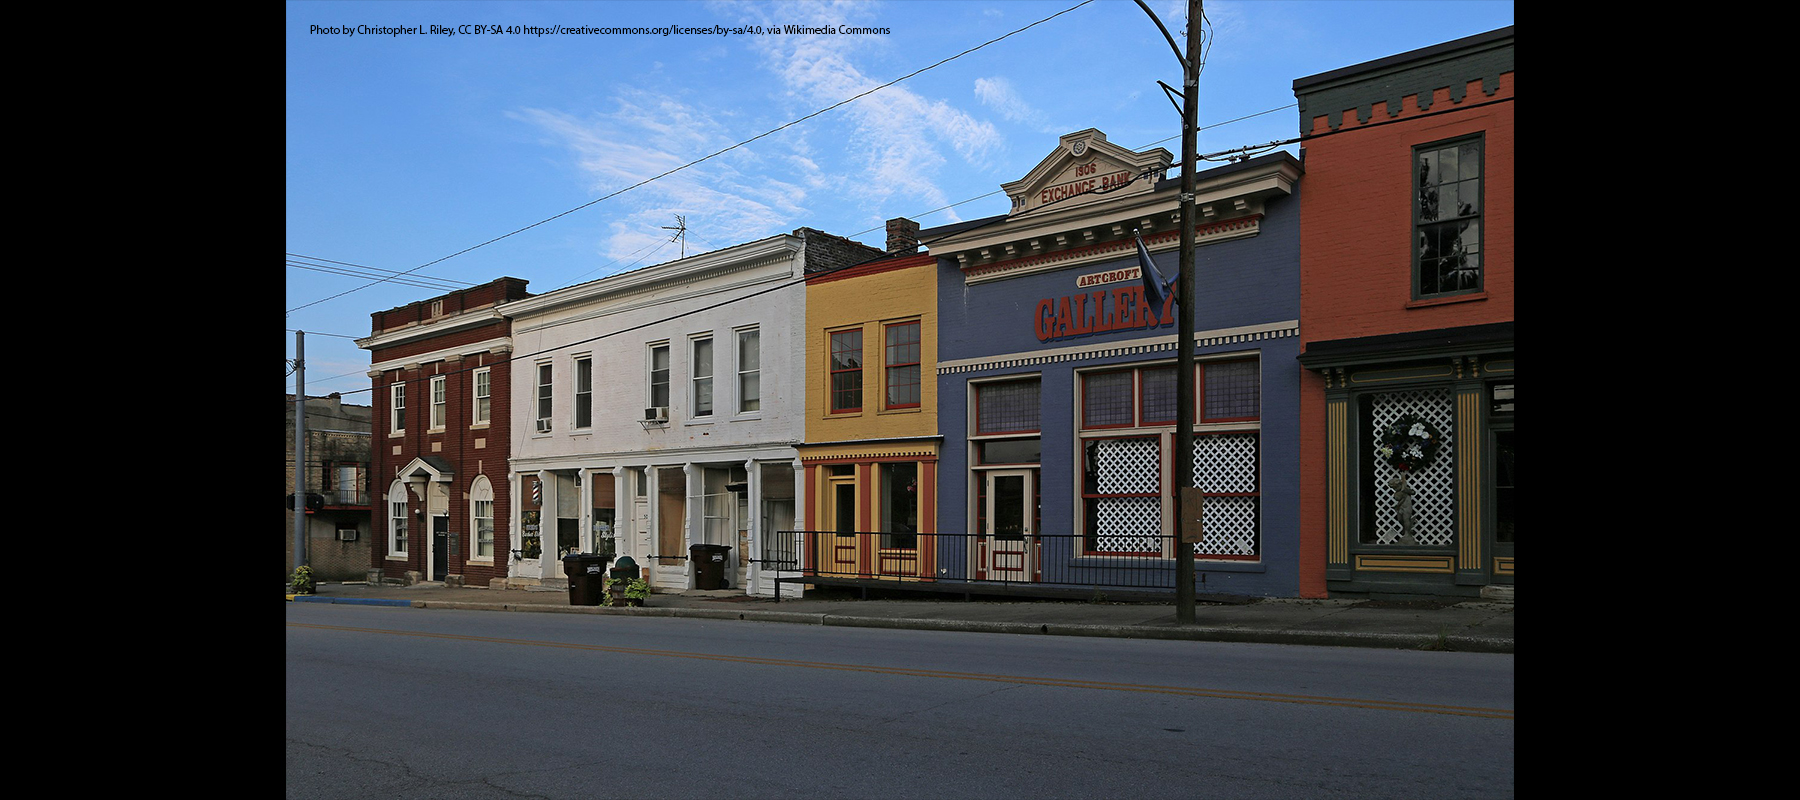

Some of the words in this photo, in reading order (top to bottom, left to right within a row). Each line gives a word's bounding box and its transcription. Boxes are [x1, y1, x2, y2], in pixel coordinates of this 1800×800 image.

[1075, 162, 1097, 178] 1906
[1102, 171, 1132, 190] BANK
[1079, 268, 1140, 287] ARTCROFT
